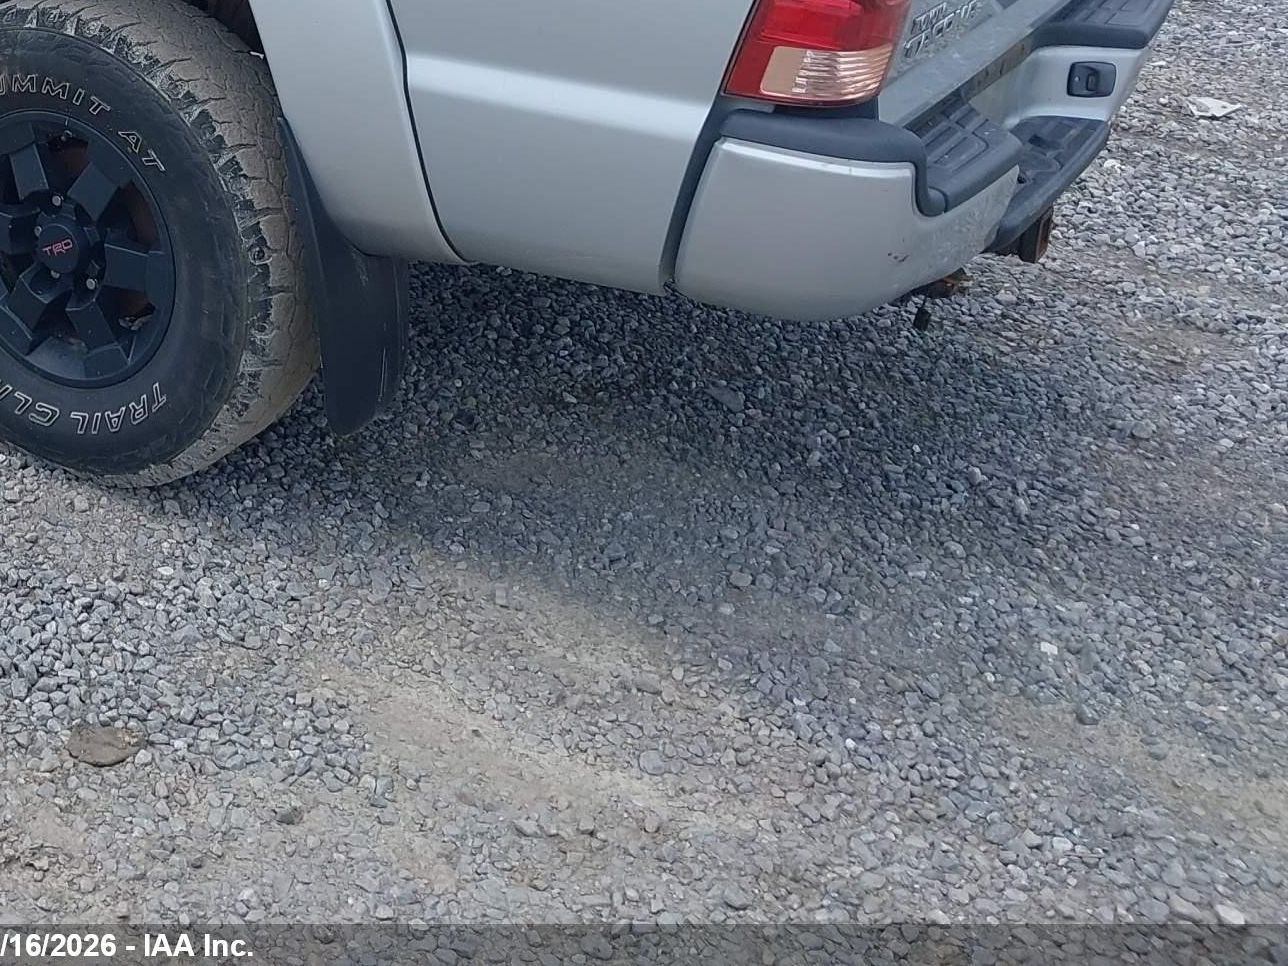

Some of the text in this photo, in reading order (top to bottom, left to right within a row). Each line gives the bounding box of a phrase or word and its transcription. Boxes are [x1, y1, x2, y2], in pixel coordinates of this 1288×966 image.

[116, 128, 166, 174] AT
[41, 238, 73, 257] TRD
[70, 380, 168, 435] TRAIL
